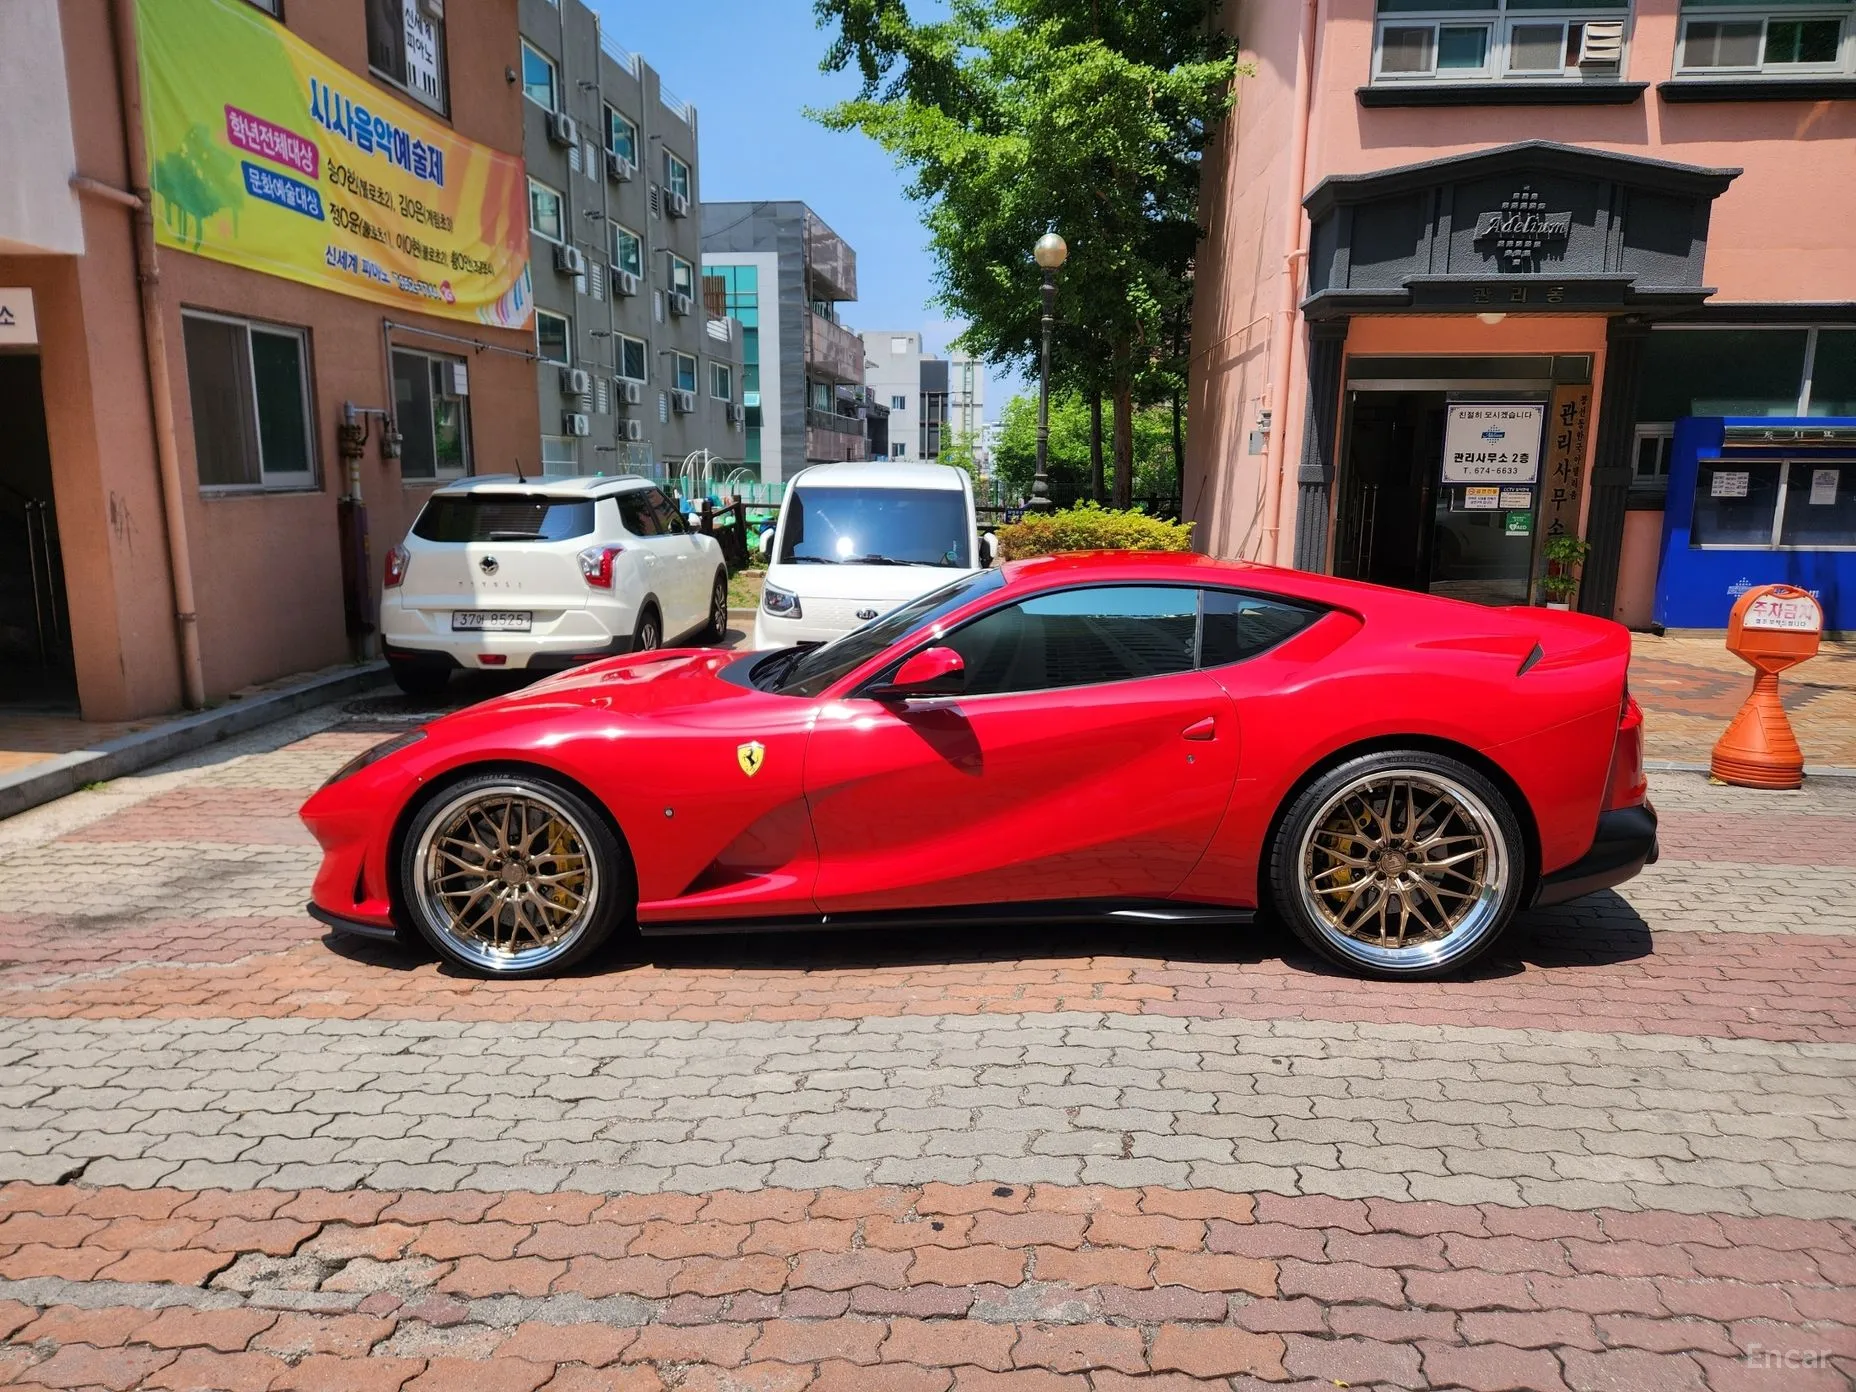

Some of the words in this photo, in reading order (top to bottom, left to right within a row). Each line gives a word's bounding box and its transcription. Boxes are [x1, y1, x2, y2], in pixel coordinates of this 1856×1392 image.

[229, 111, 314, 173] 학년전체대상
[310, 77, 444, 188] 시사음악예술제
[248, 167, 319, 216] 문화예술대상
[325, 244, 359, 274] 신세계
[1474, 286, 1565, 304] 관리동
[1458, 411, 1482, 419] 친절히
[1484, 411, 1532, 420] 모시겠습니다
[1454, 452, 1508, 463] 관리사무소
[1512, 453, 1529, 463] 2층
[1547, 400, 1578, 537] 관리사무소
[490, 613, 524, 626] 8525
